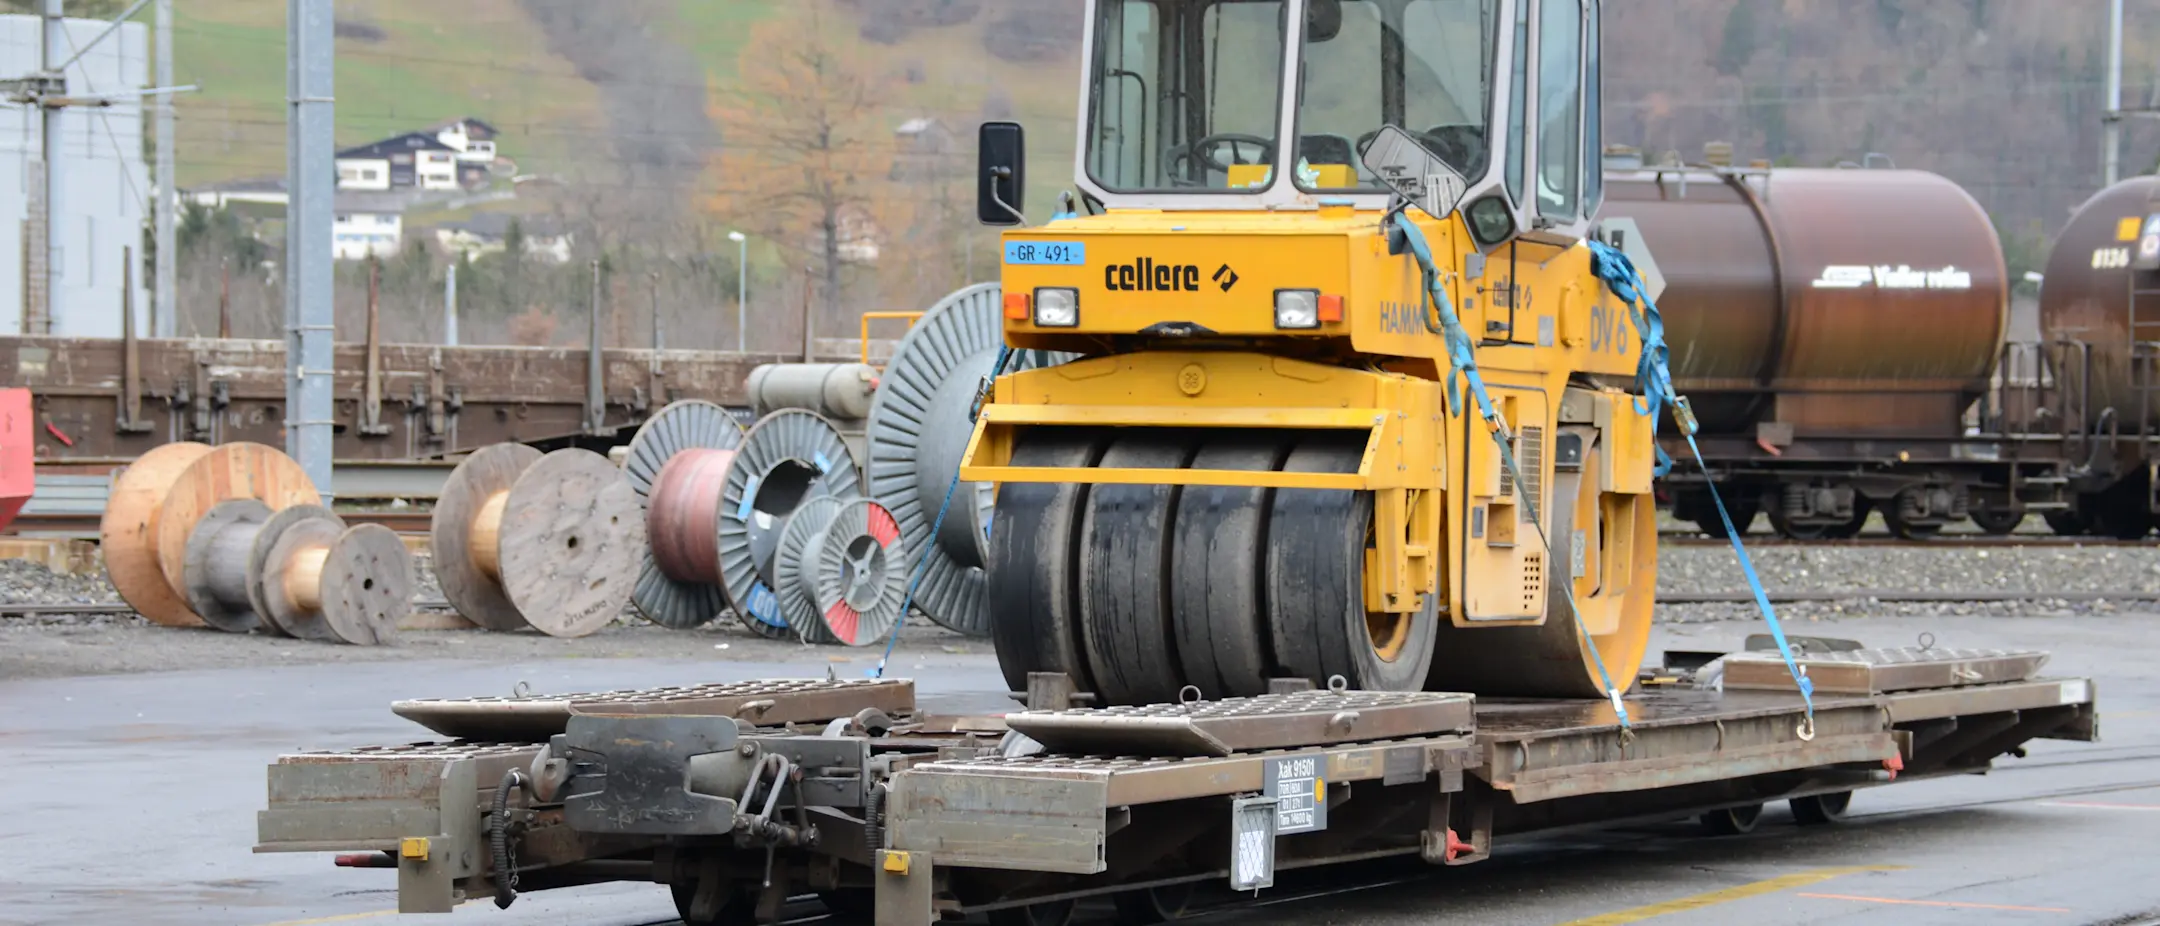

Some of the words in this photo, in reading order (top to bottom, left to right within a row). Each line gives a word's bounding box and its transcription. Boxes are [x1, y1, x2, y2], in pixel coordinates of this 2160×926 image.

[1105, 257, 1199, 291] cellere
[1617, 309, 1627, 355] 6
[1278, 760, 1293, 778] Xak
[1294, 758, 1315, 777] 91501
